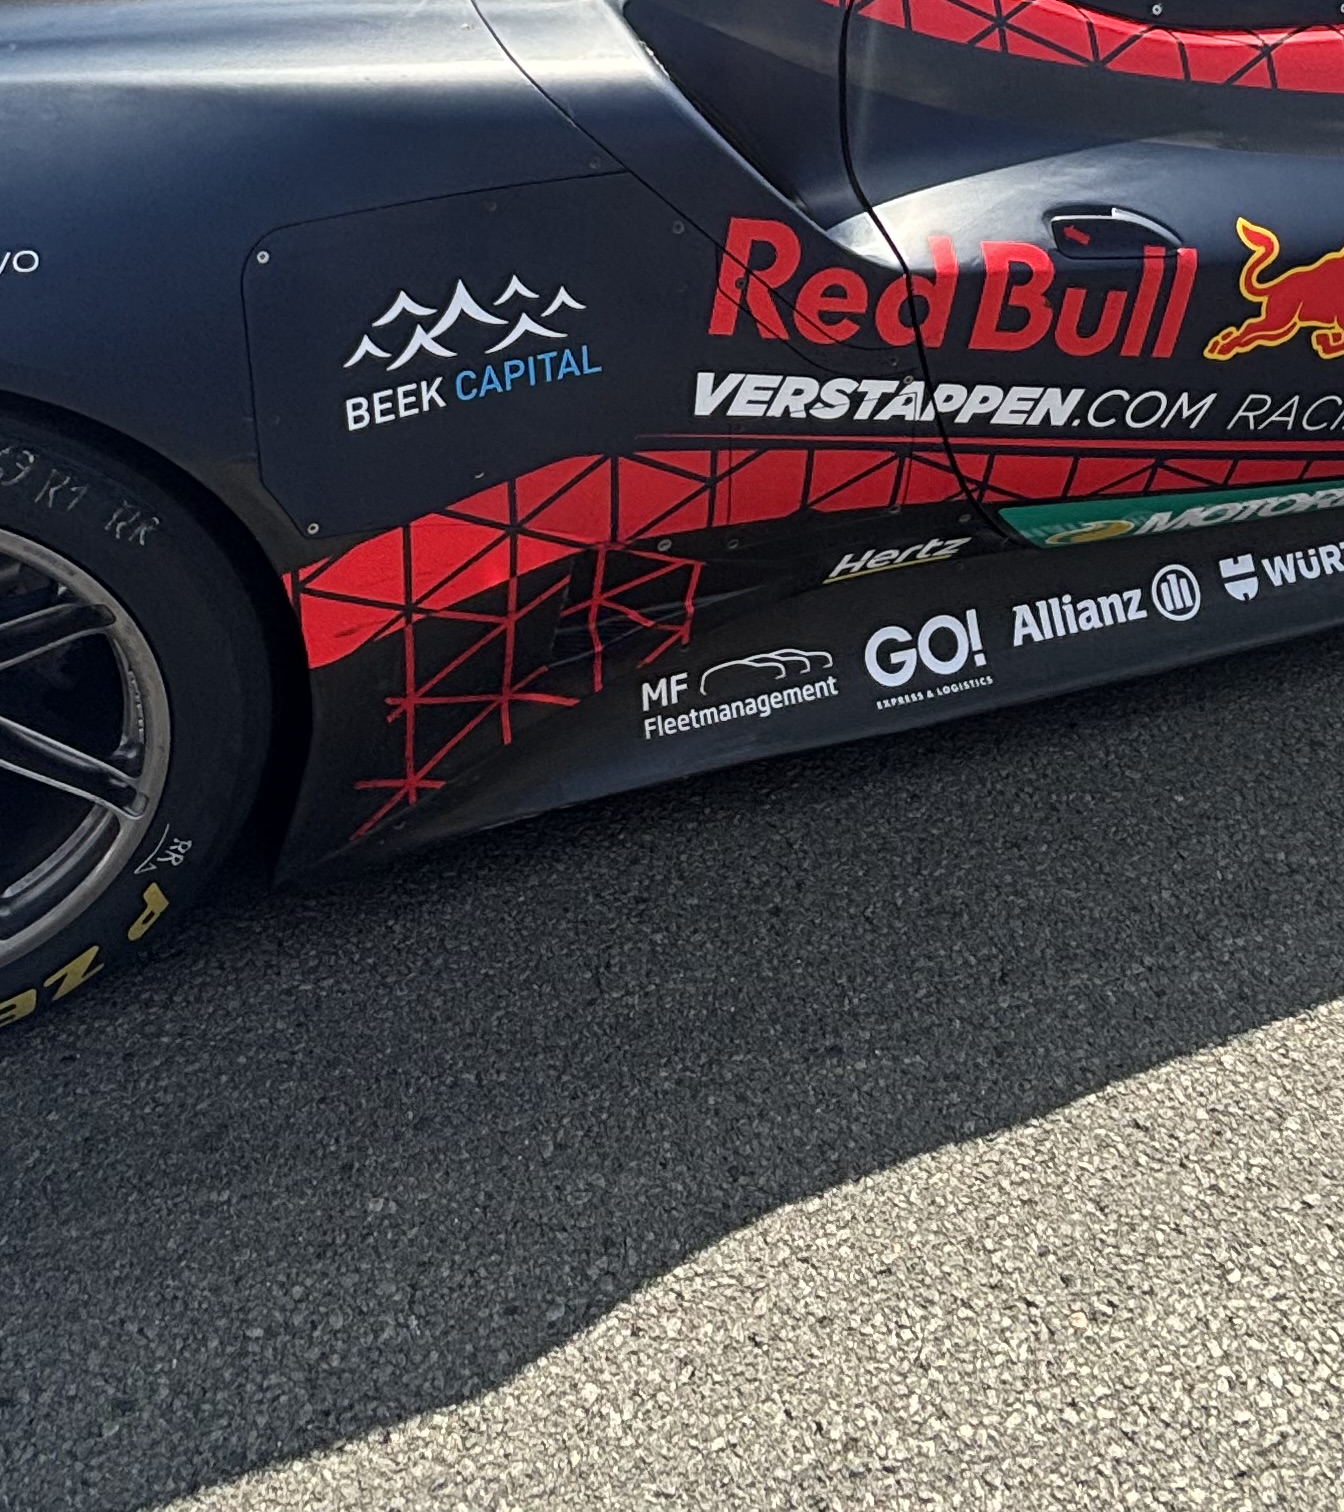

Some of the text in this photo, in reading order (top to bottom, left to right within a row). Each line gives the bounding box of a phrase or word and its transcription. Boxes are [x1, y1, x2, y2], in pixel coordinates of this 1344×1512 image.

[707, 215, 1198, 359] Red Bull
[345, 345, 603, 432] BEEK CAPITAL
[692, 371, 1222, 431] VERSTAPPEN.COM
[826, 536, 972, 578] Hertz
[864, 608, 988, 688] GO!
[1012, 587, 1149, 648] Allianz
[642, 672, 690, 712] MF
[644, 675, 840, 740] Fleetmanagement
[876, 675, 994, 710] EXPRESS & LOGISTICS
[127, 881, 171, 942] P
